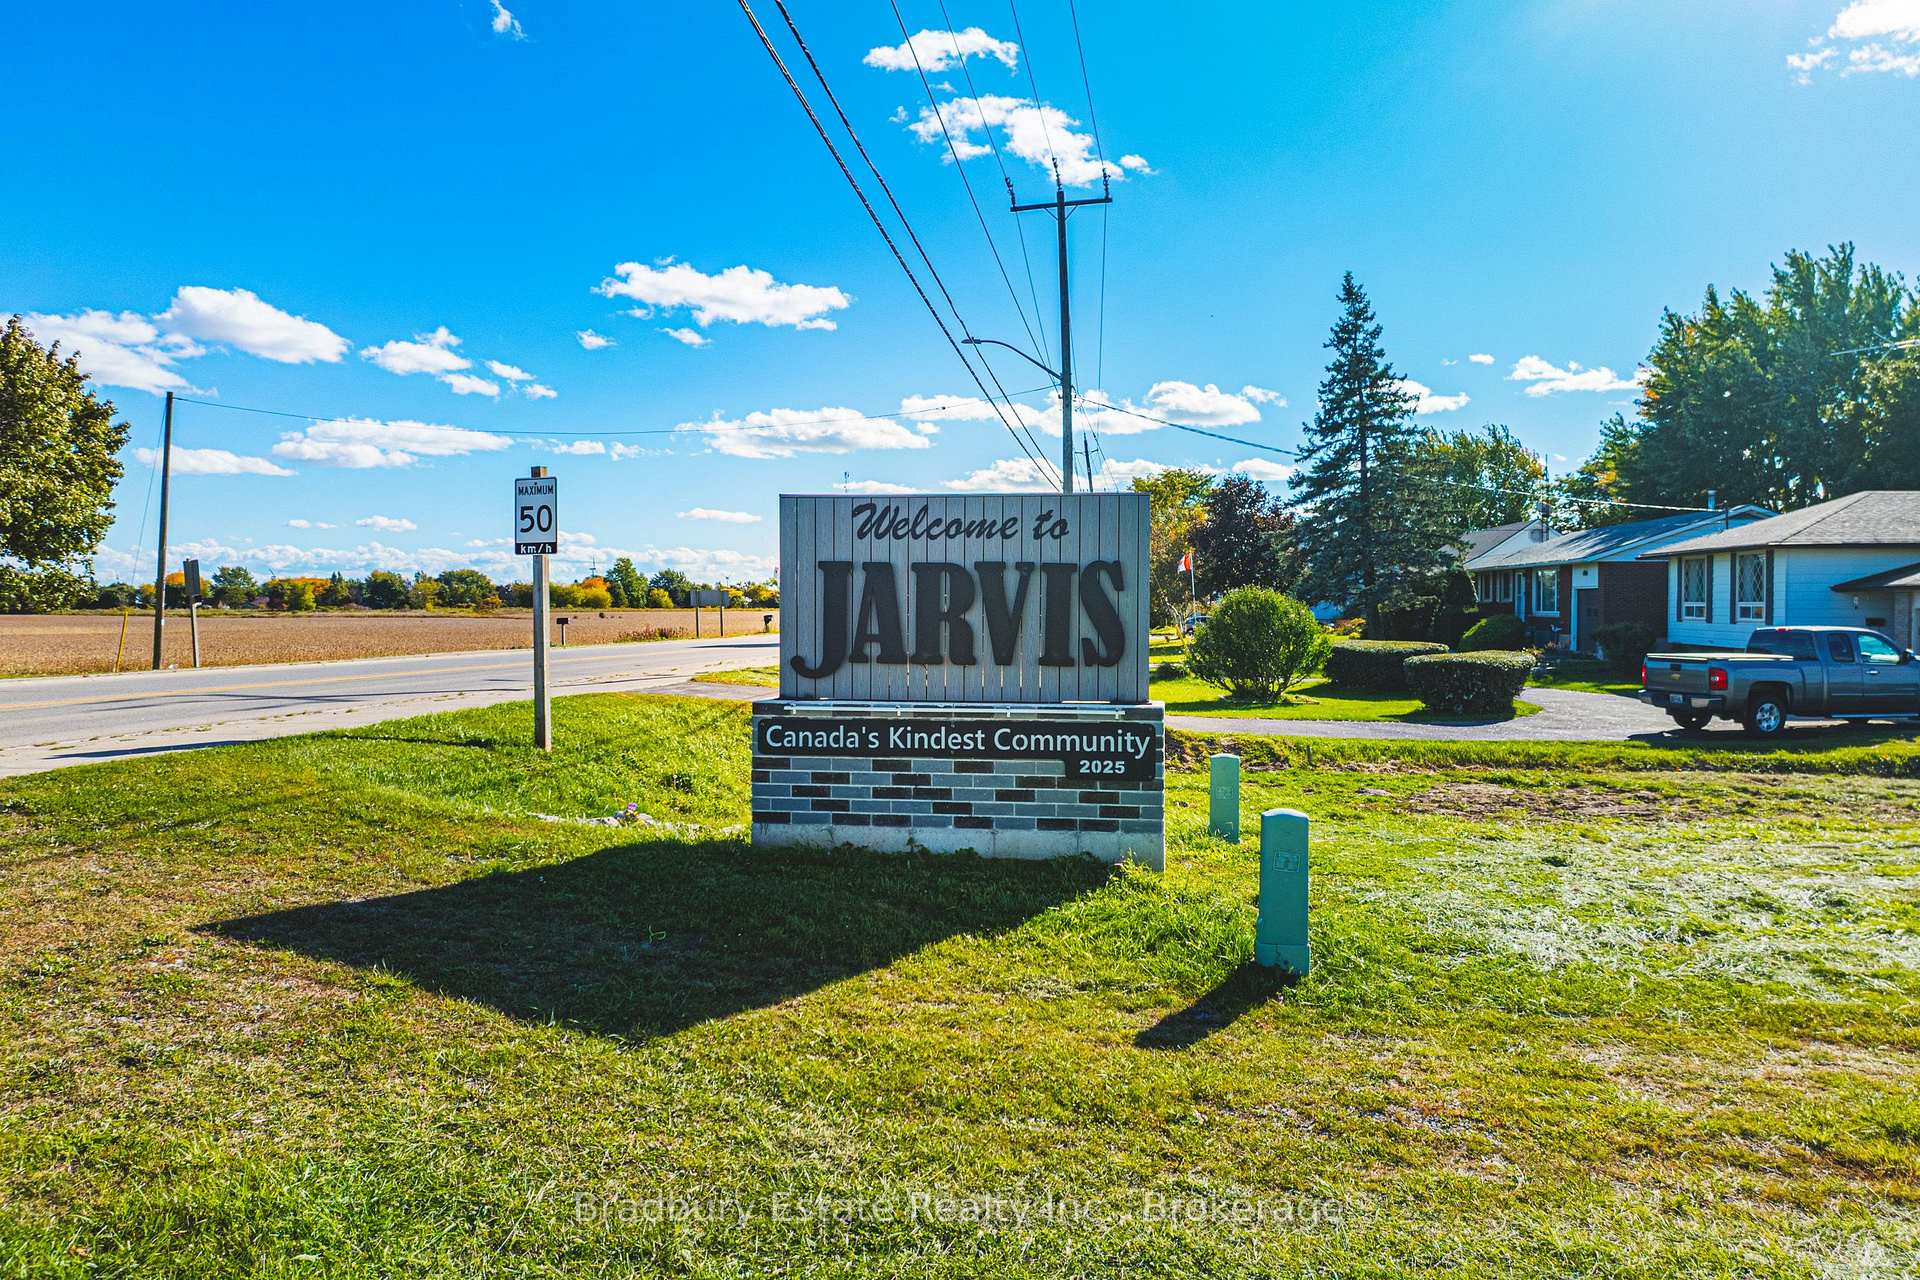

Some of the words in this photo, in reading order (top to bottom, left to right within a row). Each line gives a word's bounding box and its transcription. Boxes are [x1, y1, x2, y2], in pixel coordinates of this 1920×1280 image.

[518, 484, 554, 496] MAXIMUM
[520, 504, 553, 533] 50
[851, 502, 1018, 540] Welcome
[1032, 509, 1070, 540] to
[520, 543, 552, 554] km/h
[790, 559, 1126, 679] JARVIS
[765, 725, 879, 749] Canada's
[889, 726, 985, 751] Kindest
[994, 728, 1150, 759] Community
[1079, 759, 1125, 774] 2025
